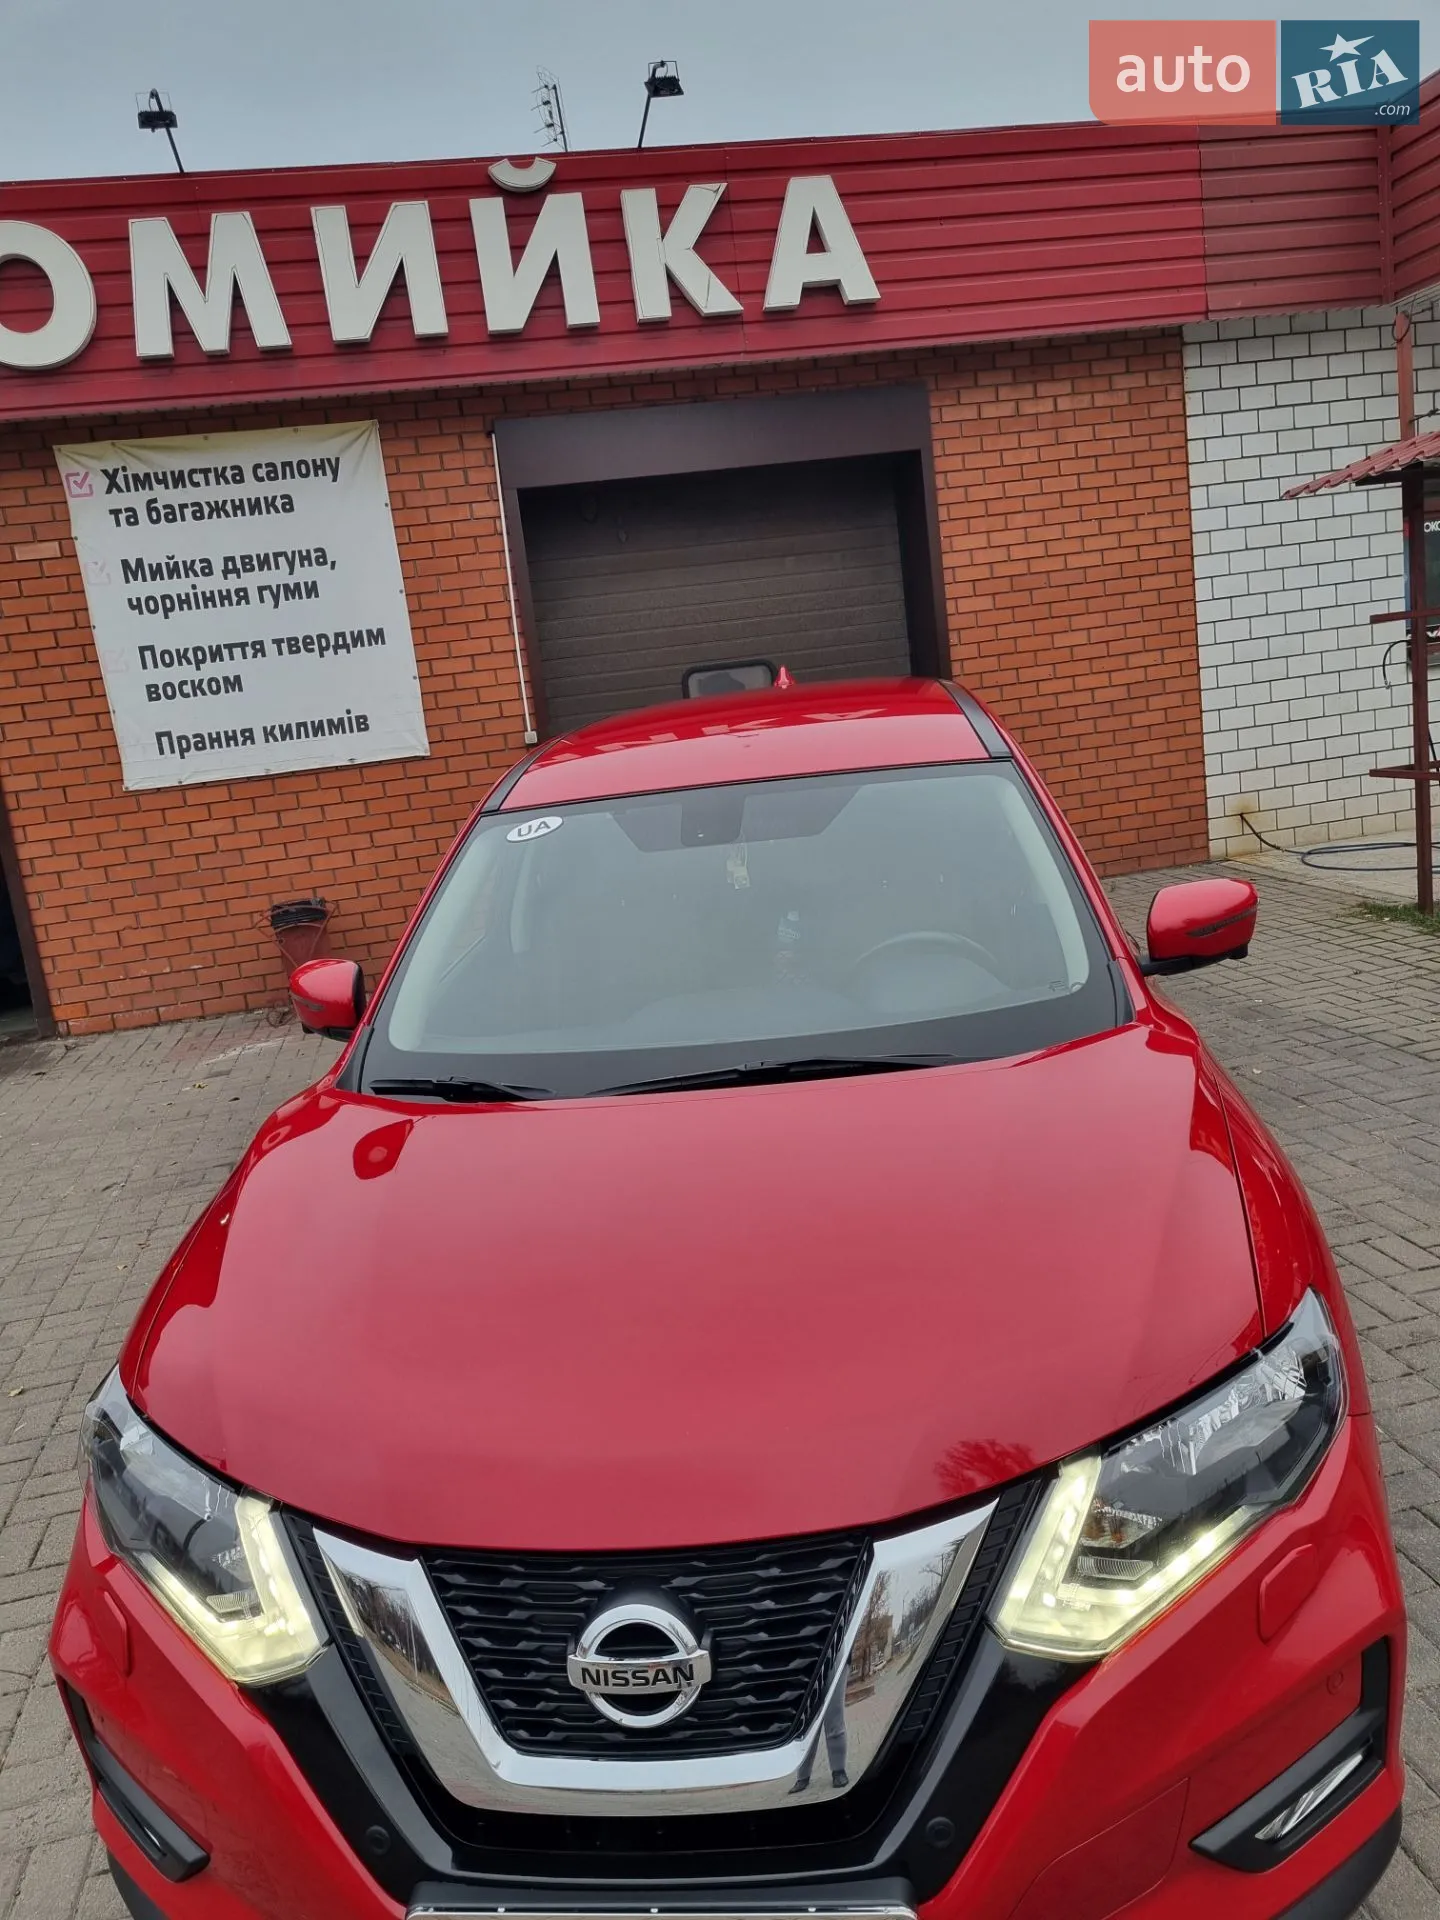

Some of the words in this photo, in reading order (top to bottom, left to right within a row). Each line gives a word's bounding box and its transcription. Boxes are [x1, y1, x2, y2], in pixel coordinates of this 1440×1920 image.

[101, 464, 245, 495] Хімчистка
[252, 456, 341, 483] салону
[109, 506, 139, 528] та
[146, 493, 295, 526] багажника
[120, 554, 214, 585] Мийка
[221, 546, 337, 580] двигуна,
[127, 584, 249, 620] чорніння
[256, 580, 320, 609] гуми
[138, 639, 266, 671] Покриття
[271, 627, 386, 660] твердим
[145, 674, 244, 703] воском
[155, 726, 256, 760] Прання
[262, 708, 370, 744] килимів
[517, 820, 551, 837] UA
[581, 1663, 695, 1688] NISSAN
